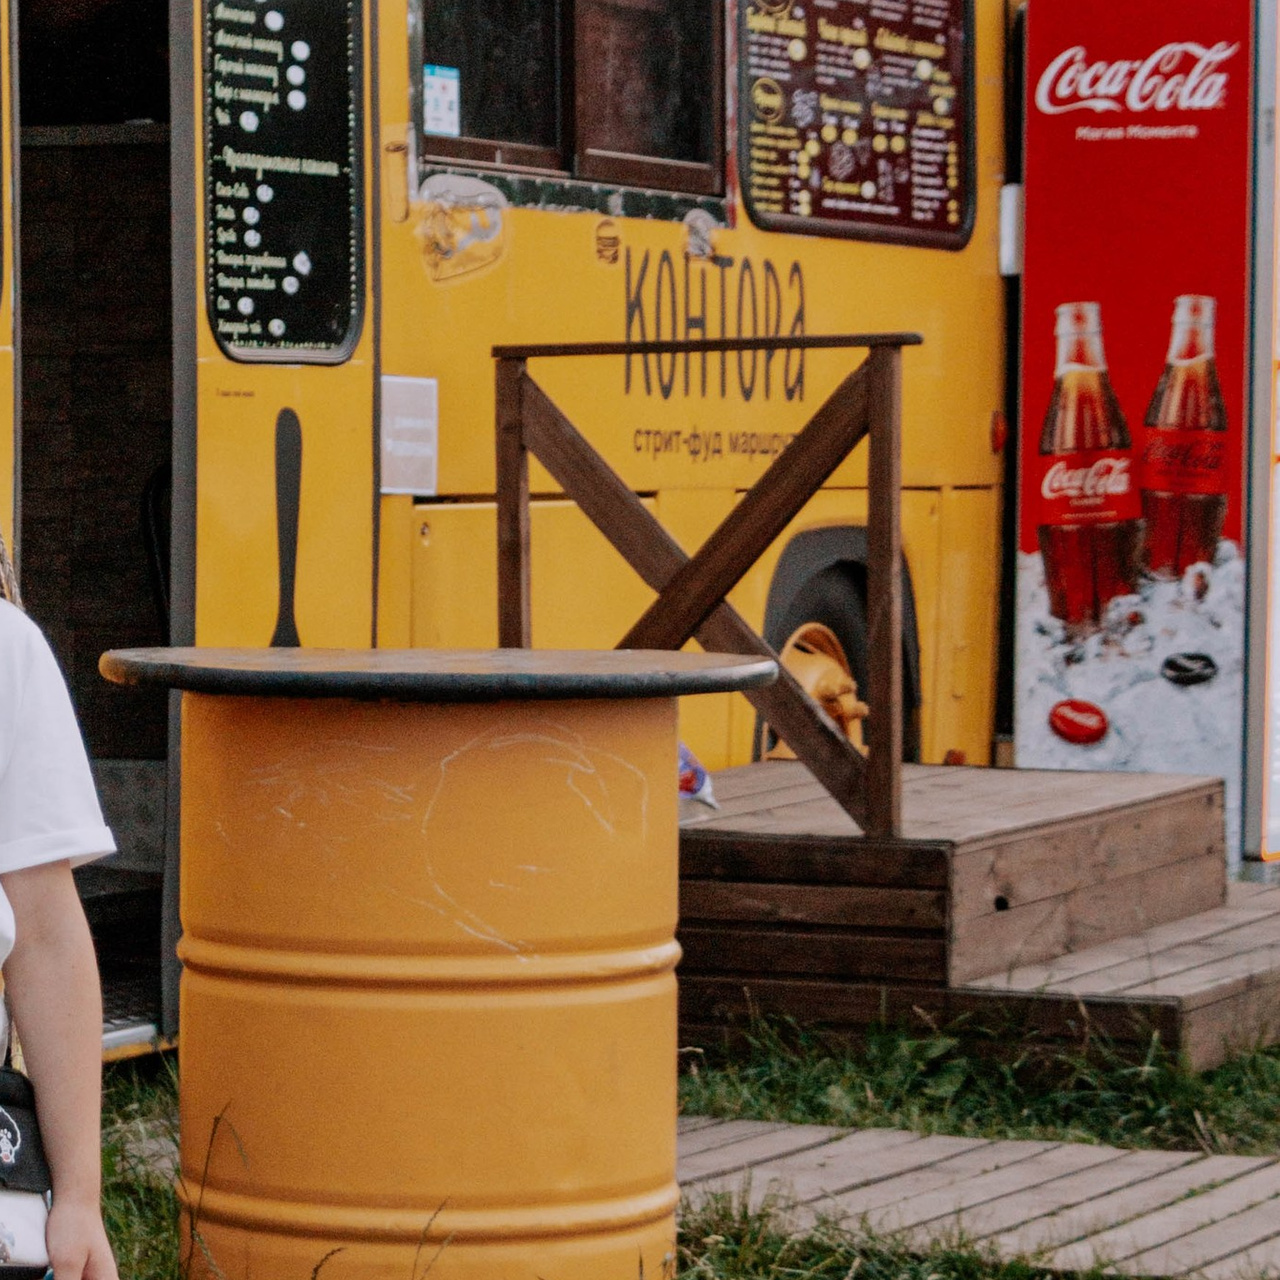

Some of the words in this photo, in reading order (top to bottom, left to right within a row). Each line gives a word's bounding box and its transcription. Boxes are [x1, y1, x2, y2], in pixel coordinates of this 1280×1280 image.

[1035, 41, 1241, 115] Coca-Cola
[633, 425, 722, 463] стрит-фуд
[1041, 457, 1131, 500] Coca-Cola
